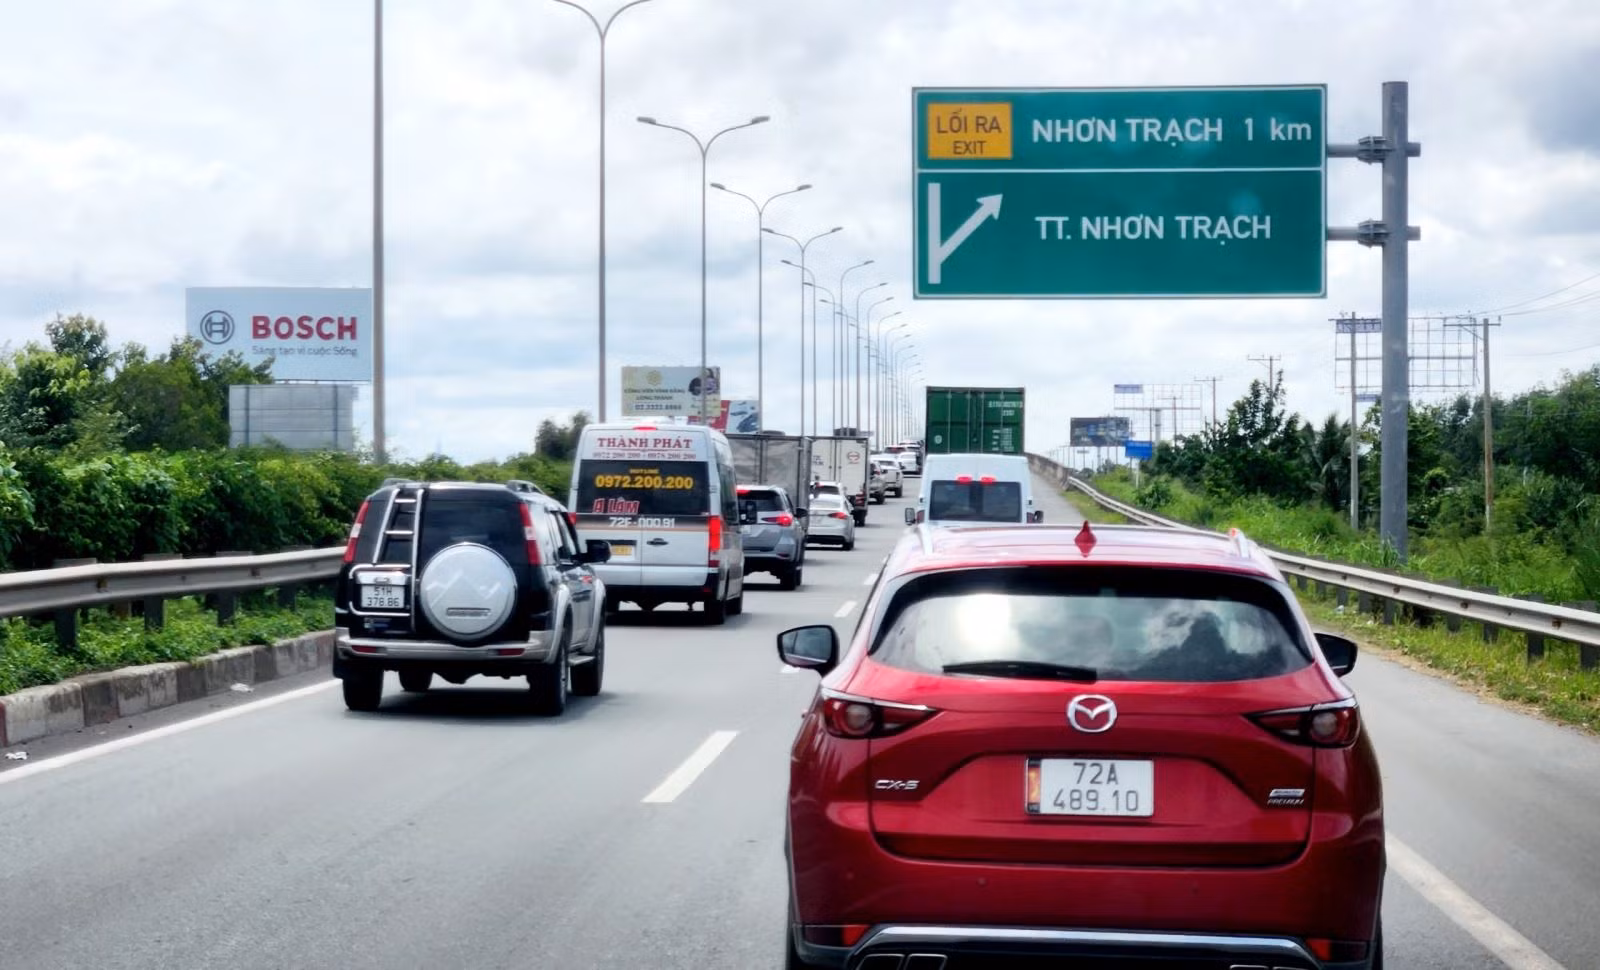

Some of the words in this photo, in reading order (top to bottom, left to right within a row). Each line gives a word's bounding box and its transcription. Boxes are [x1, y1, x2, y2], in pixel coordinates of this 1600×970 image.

[936, 108, 967, 134] LỐI
[976, 116, 1002, 133] RA
[1032, 117, 1117, 143] NHƠN
[1125, 118, 1223, 147] TRẠCH
[1244, 118, 1254, 141] 1
[1270, 118, 1312, 142] km
[953, 140, 985, 155] EXIT
[1035, 216, 1072, 240] TT.
[1081, 214, 1164, 240] NHƠN
[1175, 215, 1271, 246] TRẠCH
[252, 315, 357, 340] BOSCH
[597, 435, 648, 448] THÀNH
[653, 436, 693, 449] PHÁT
[595, 474, 694, 489] 0972.200.200
[875, 779, 920, 790] CX-5
[1073, 762, 1119, 785] 72A
[1053, 789, 1139, 812] 489.10
